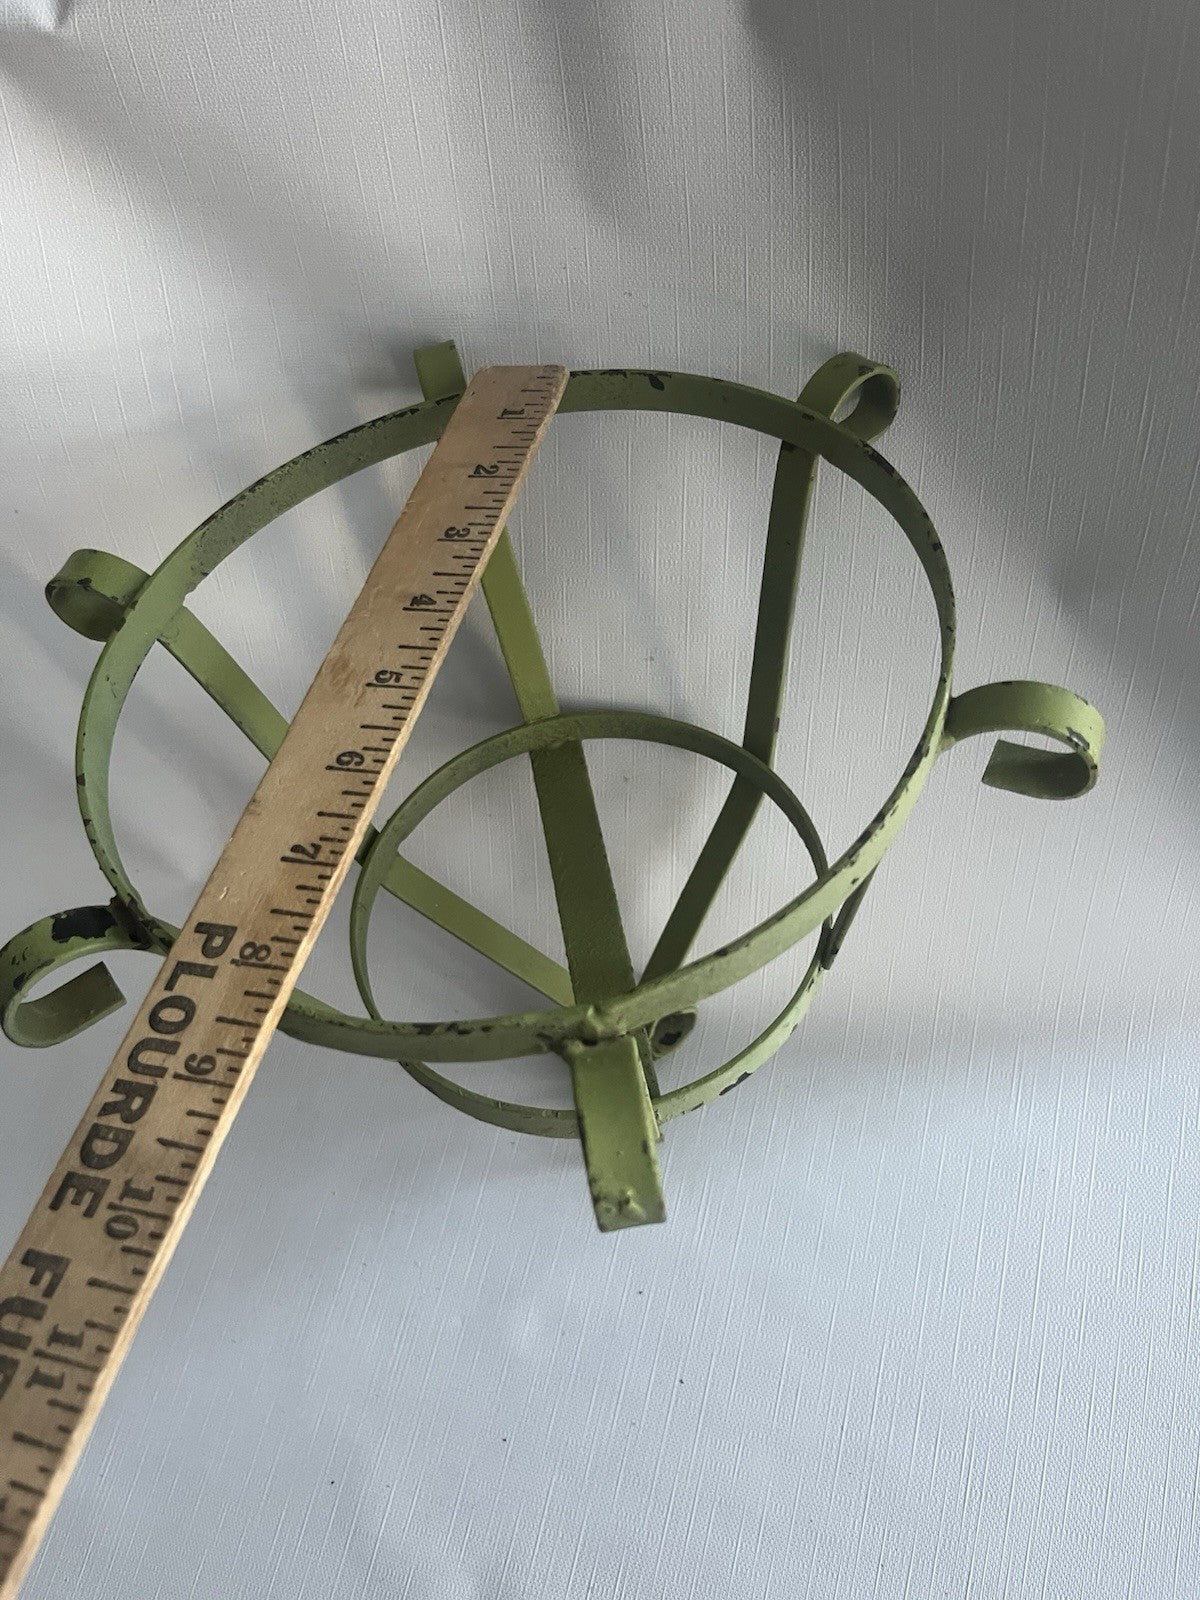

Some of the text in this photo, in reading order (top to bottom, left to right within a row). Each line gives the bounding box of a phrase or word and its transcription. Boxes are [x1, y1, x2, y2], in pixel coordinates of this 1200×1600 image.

[501, 408, 525, 417] 1
[473, 464, 499, 475] 2
[444, 526, 470, 538] 3
[410, 594, 437, 607] 4
[374, 669, 403, 683] 5
[335, 751, 365, 767] 6
[290, 843, 322, 859] 7
[239, 941, 271, 962] 8
[49, 922, 237, 1219] PLOURDE
[184, 1053, 217, 1075] 9
